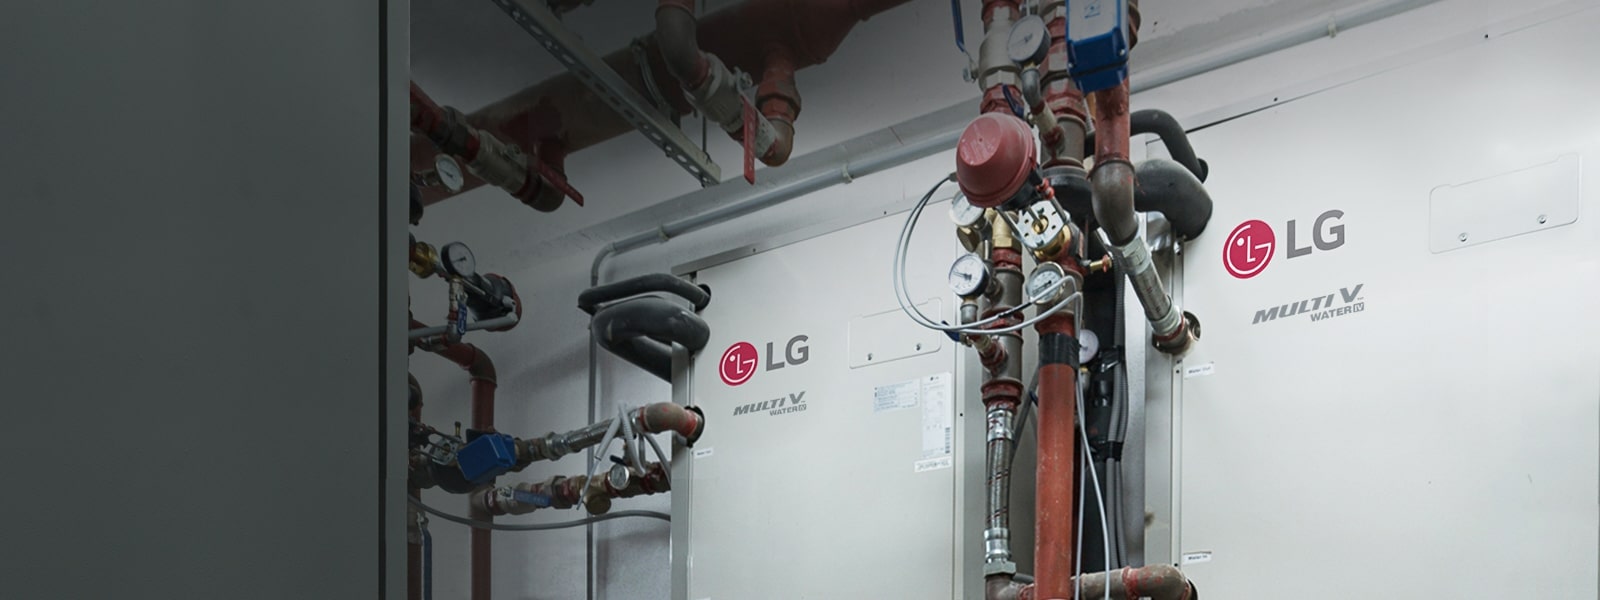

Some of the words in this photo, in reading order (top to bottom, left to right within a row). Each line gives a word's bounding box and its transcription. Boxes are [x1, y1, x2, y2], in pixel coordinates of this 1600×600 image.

[1286, 209, 1346, 259] LG
[1252, 293, 1335, 325] MULTI
[1310, 305, 1352, 322] WATER
[766, 334, 809, 372] LG
[733, 397, 786, 416] MULTI
[769, 406, 798, 416] WATER
